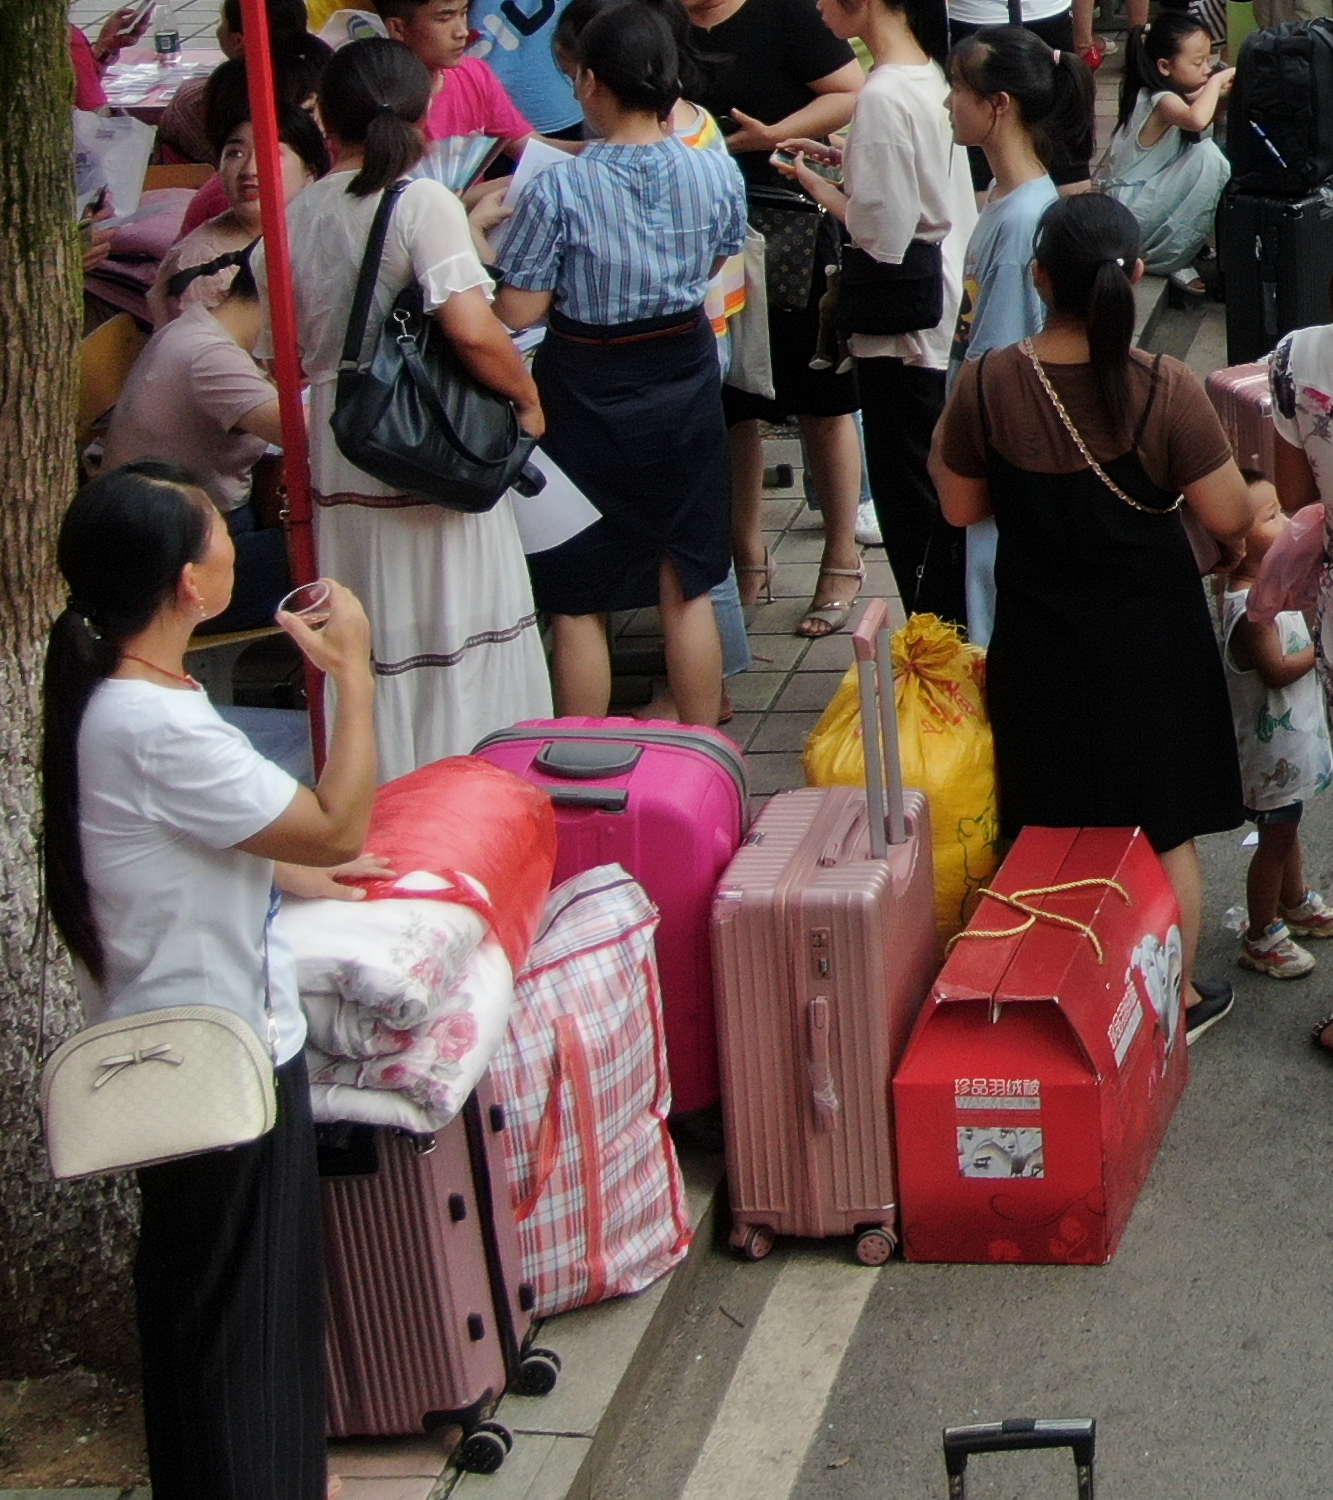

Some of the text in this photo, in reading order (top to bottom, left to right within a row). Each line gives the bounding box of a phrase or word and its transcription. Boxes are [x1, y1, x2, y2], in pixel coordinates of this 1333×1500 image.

[954, 1078, 1041, 1097] 珍品羽绒被
